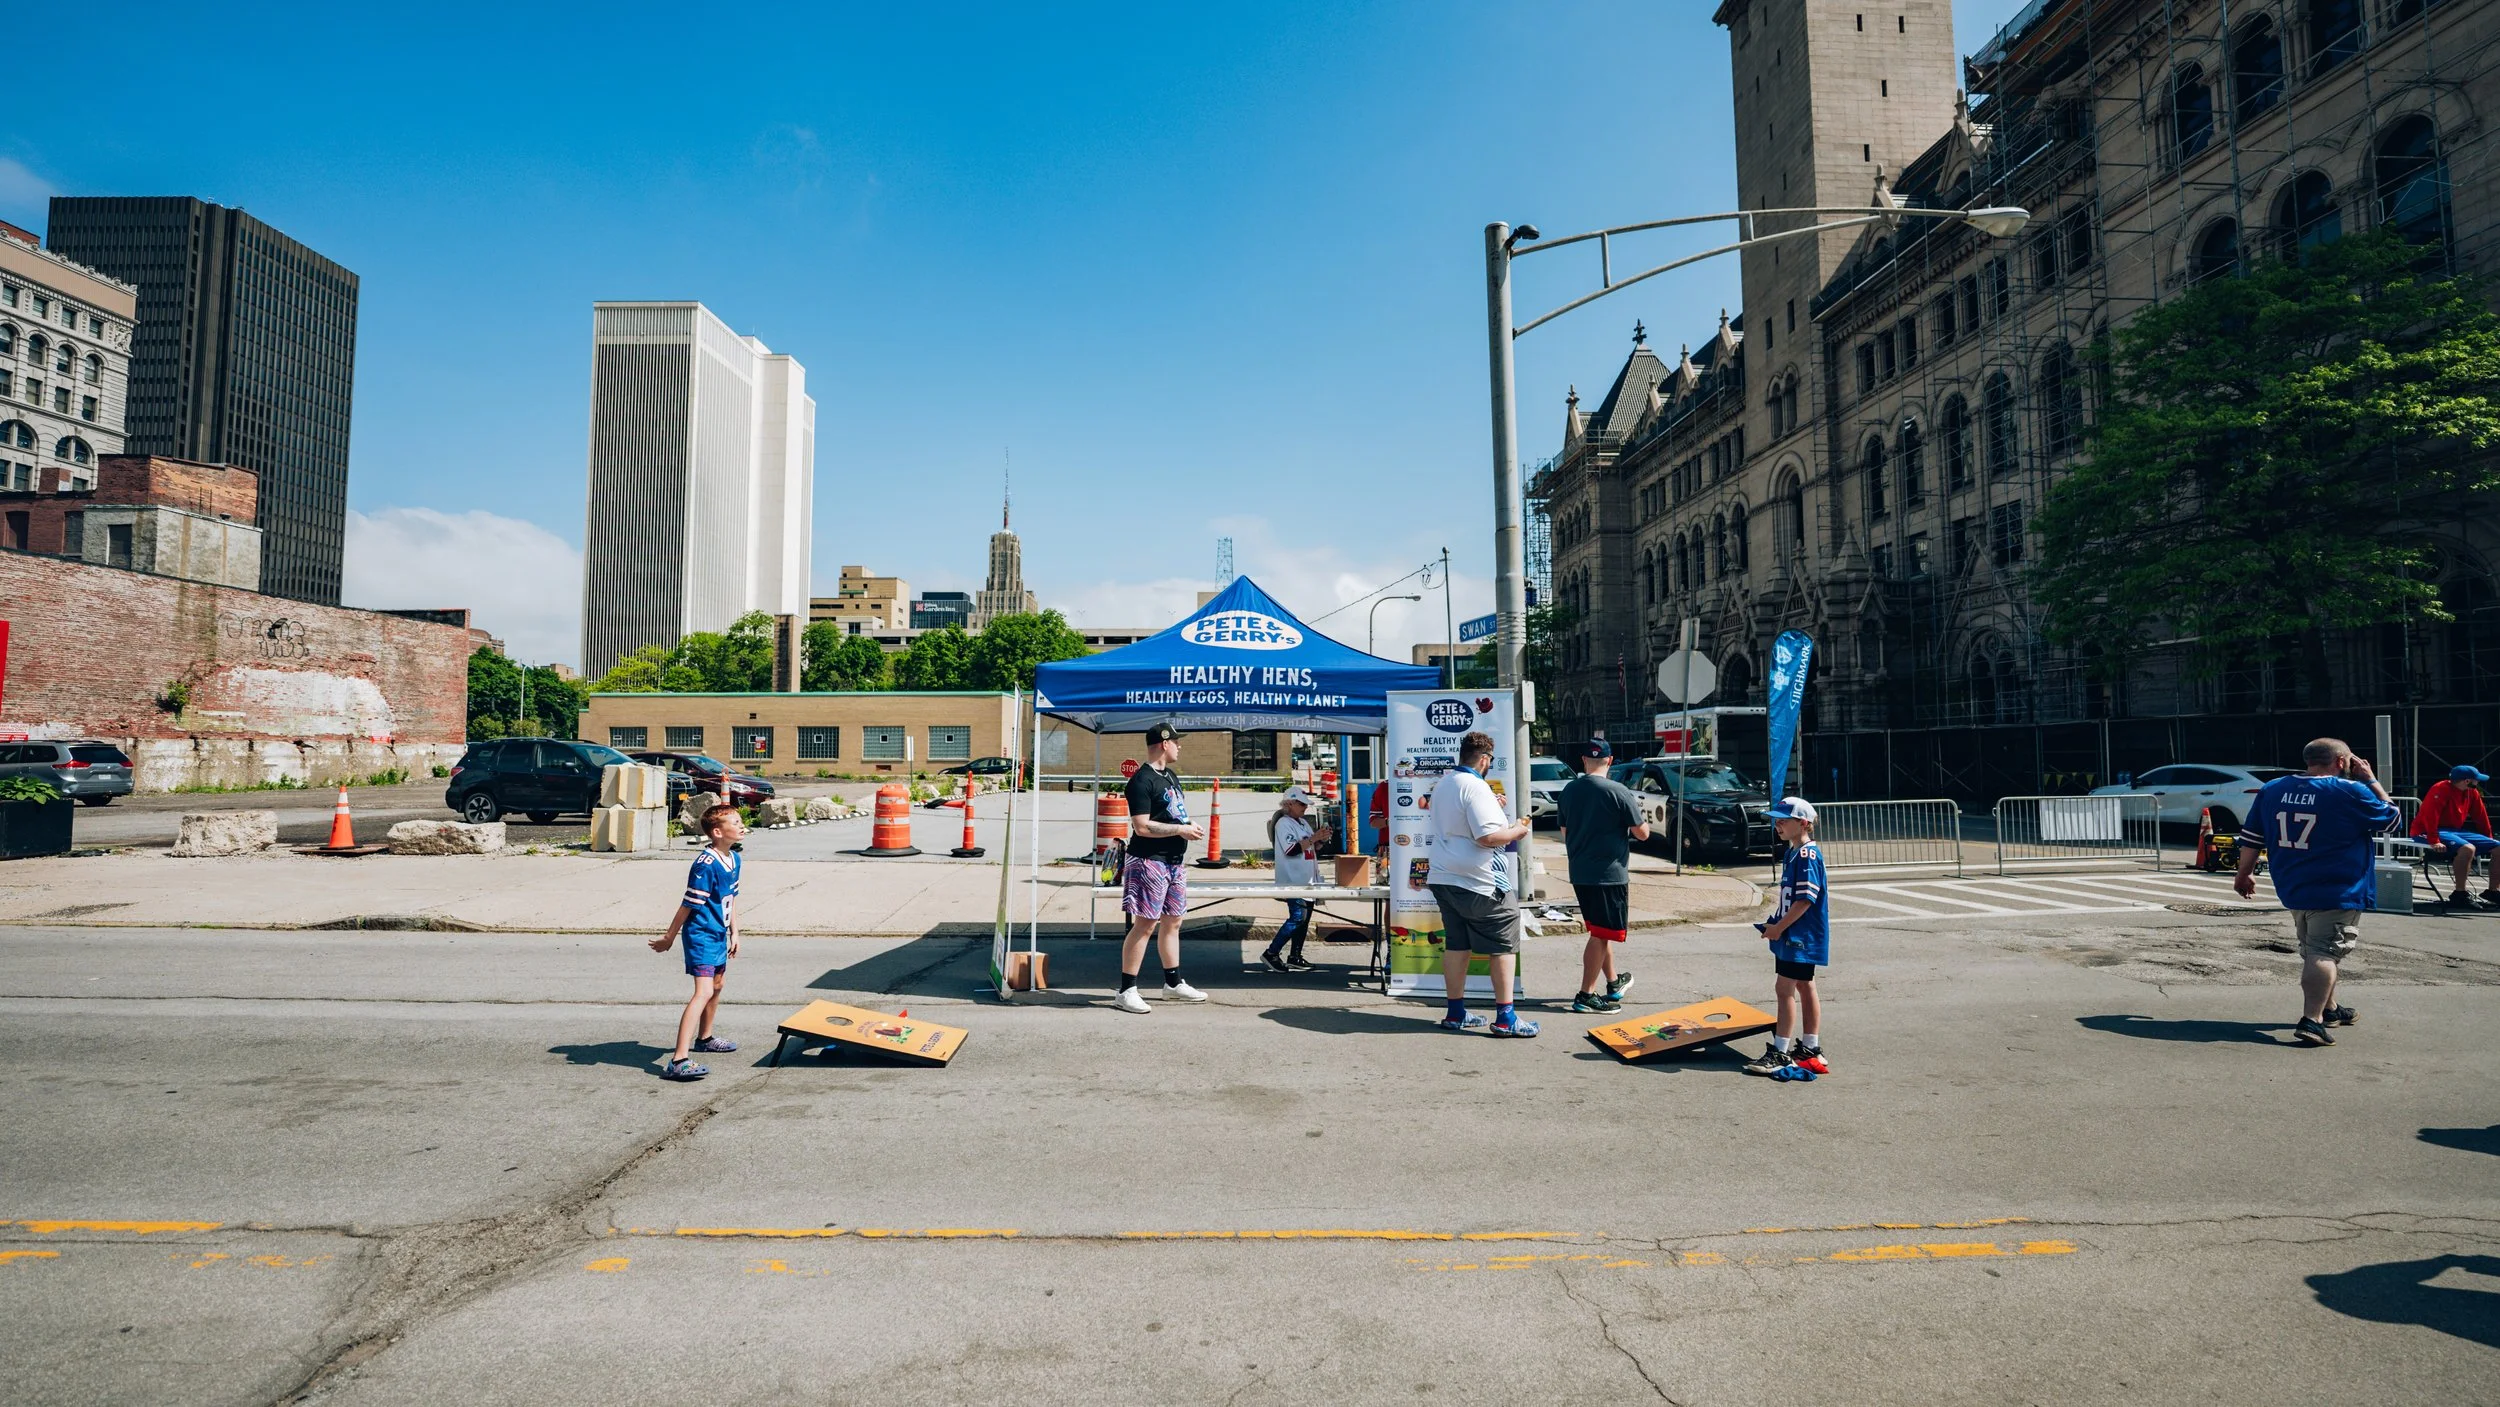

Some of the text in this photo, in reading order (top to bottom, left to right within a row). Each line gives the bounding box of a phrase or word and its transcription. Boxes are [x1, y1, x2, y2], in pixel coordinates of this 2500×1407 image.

[1197, 616, 1283, 631] PETE &
[1461, 620, 1496, 640] SWAN ST
[1170, 665, 1318, 691] HEALTHY HENS,
[1792, 643, 1811, 704] HIGHMARK
[1126, 691, 1348, 708] HEALTHY EGGS, HEALTHY PLANET
[1431, 703, 1466, 714] PETE &
[1664, 720, 1683, 729] U-HAU
[1423, 737, 1456, 745] HEALTHY
[1121, 765, 1138, 773] STOP
[1420, 759, 1450, 767] ORGANIC
[2281, 792, 2316, 805] ALLEN
[2275, 811, 2317, 850] 17
[697, 854, 715, 865] 86
[1800, 847, 1817, 860] 86
